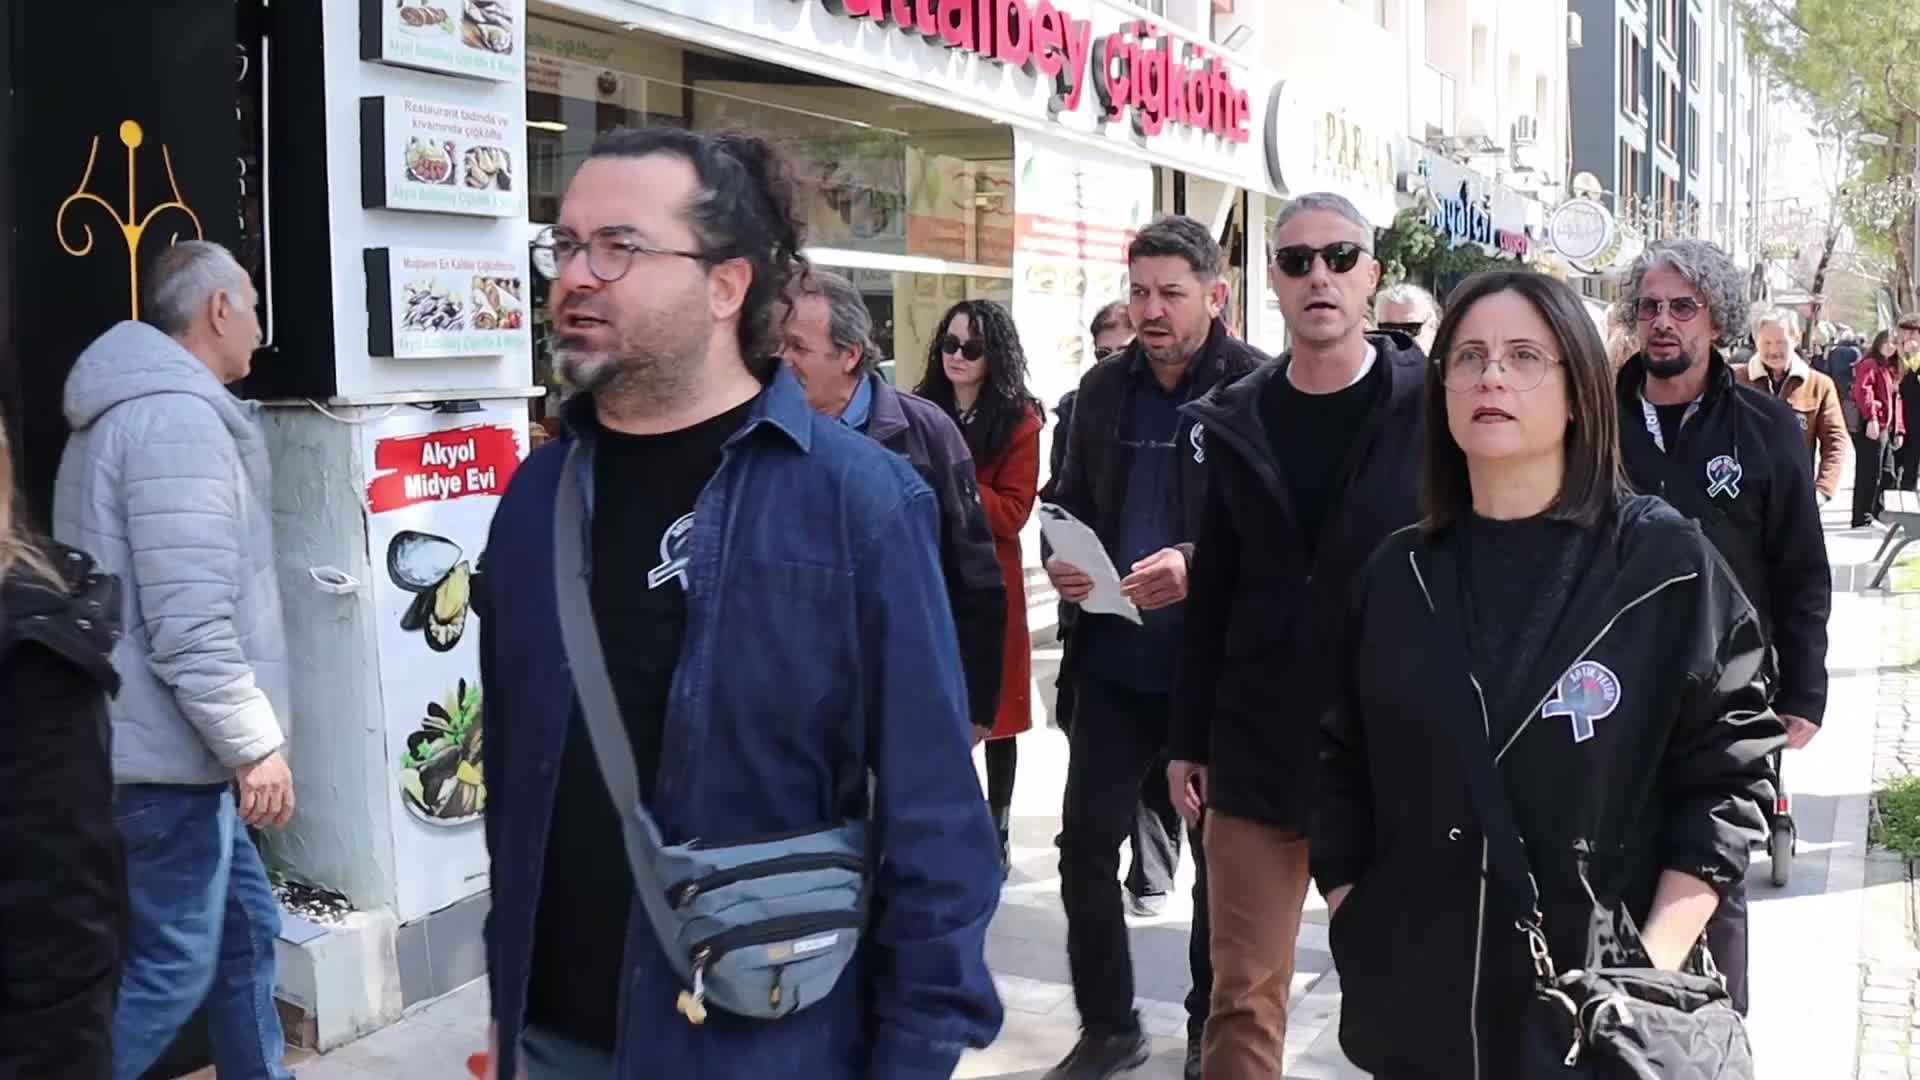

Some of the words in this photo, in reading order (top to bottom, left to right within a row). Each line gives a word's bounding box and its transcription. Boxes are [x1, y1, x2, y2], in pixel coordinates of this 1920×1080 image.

[421, 438, 476, 469] Akyol
[403, 472, 462, 500] Midye
[466, 466, 496, 491] Evi
